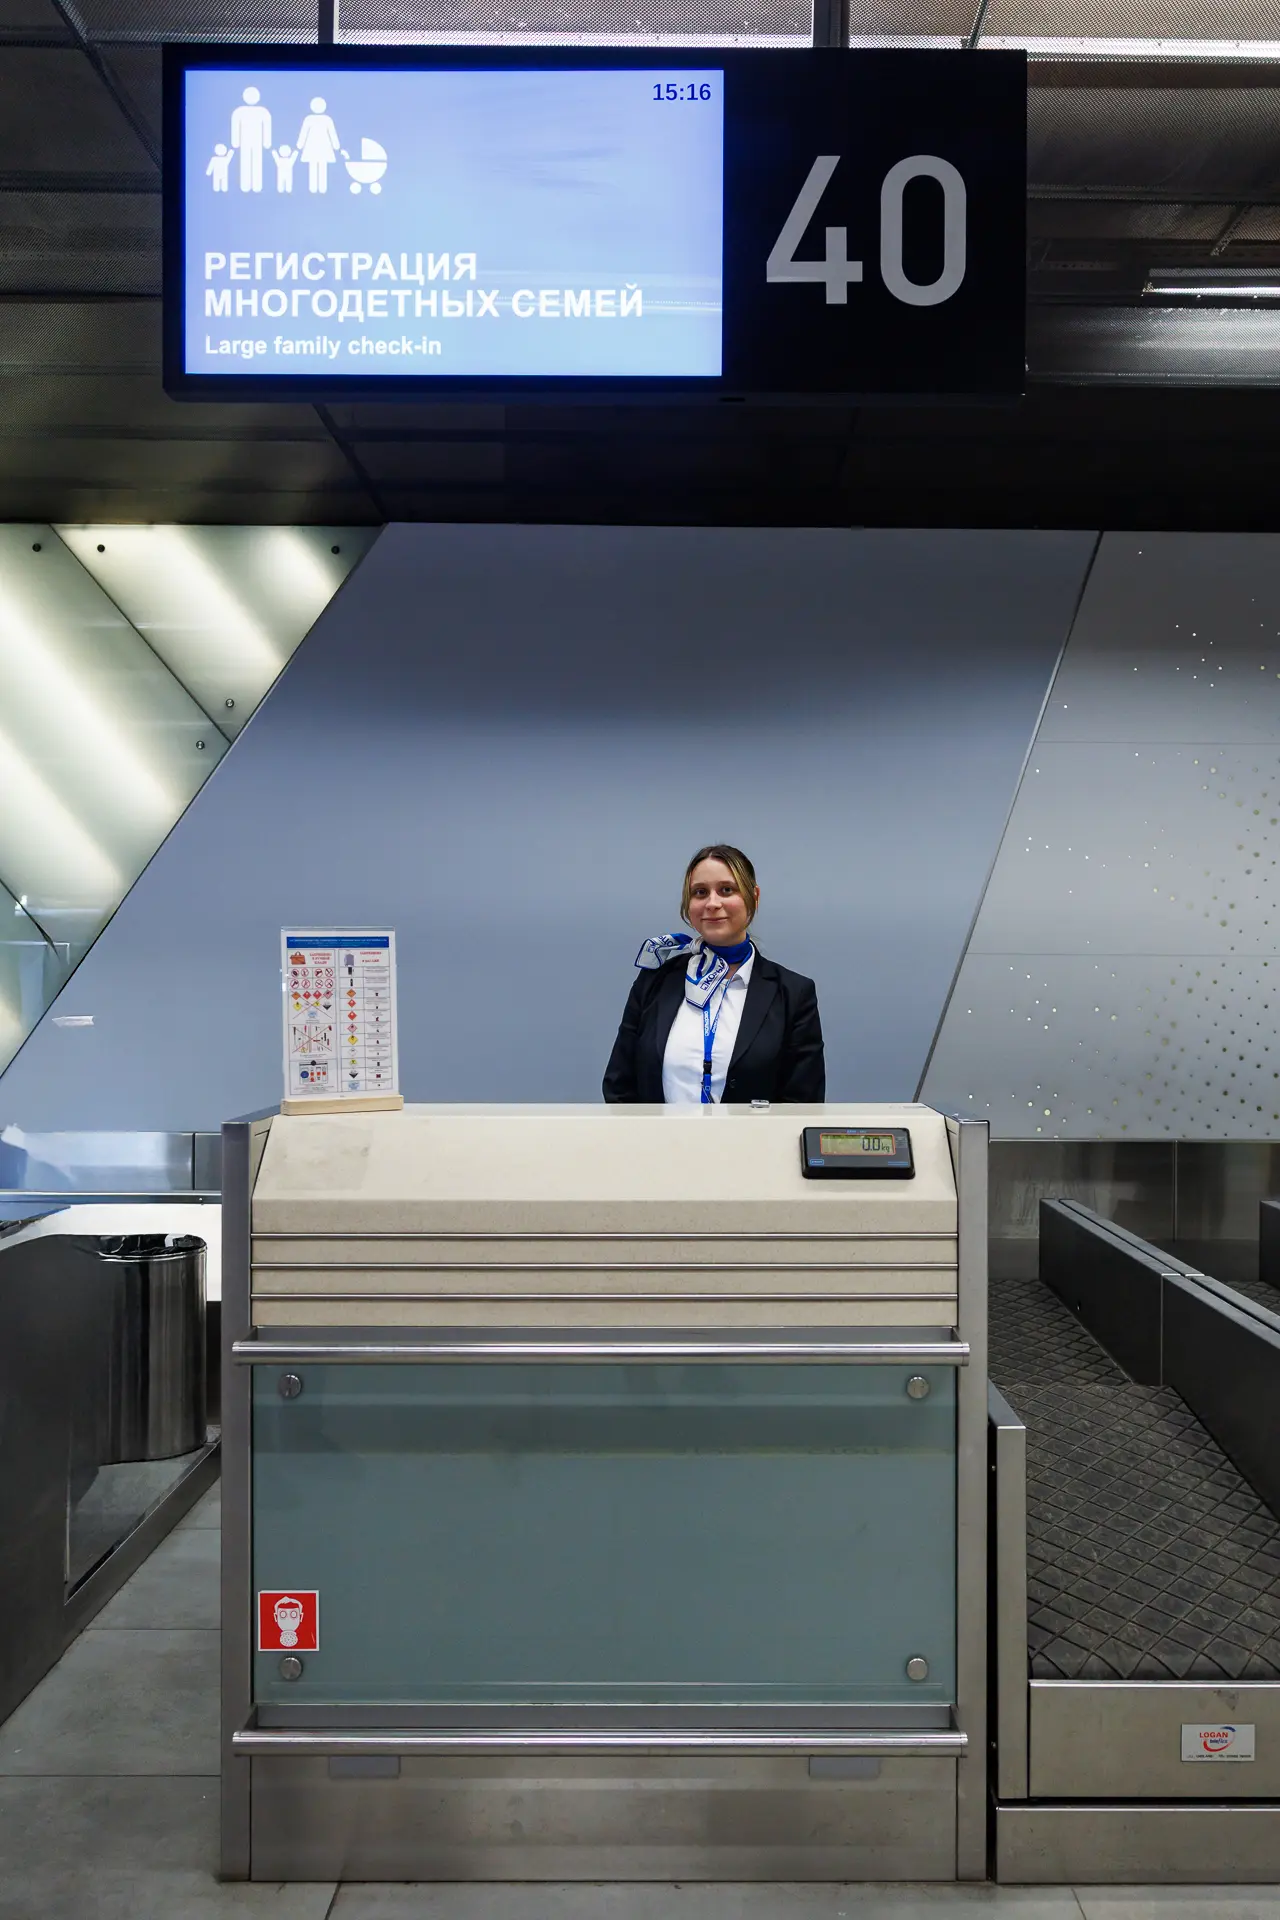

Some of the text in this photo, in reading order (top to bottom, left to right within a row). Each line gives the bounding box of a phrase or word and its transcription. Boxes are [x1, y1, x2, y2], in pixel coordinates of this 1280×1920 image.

[652, 83, 712, 101] 15:16
[766, 154, 967, 307] 40
[204, 252, 477, 285] РЕГИСТРАЦИЯ
[204, 283, 644, 322] МНОГОДЕТНЫХ СЕМЕЙ
[204, 334, 442, 358] Large family check-in
[862, 1136, 880, 1151] 0.0
[881, 1142, 890, 1153] kg
